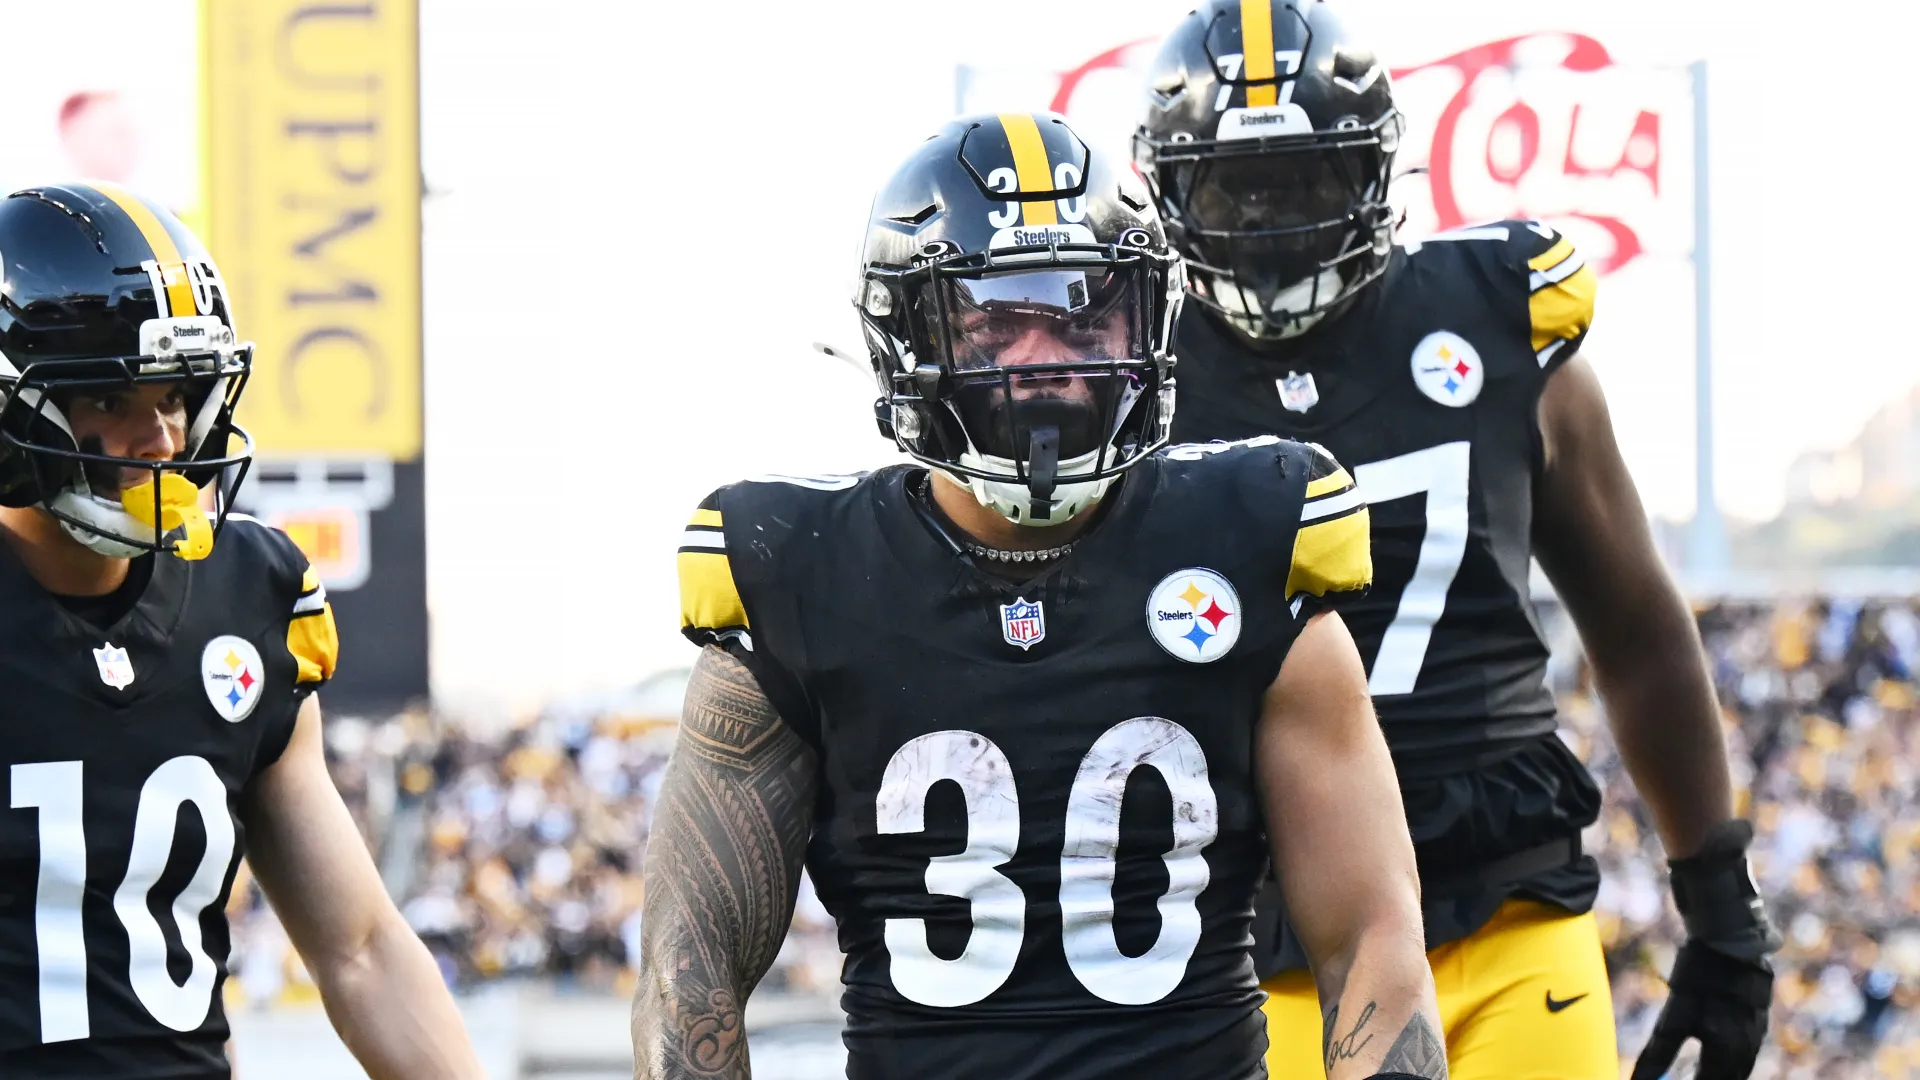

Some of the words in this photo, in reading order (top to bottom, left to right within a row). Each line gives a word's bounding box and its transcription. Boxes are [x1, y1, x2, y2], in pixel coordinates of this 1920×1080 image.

[1214, 50, 1302, 111] 77
[275, 2, 389, 426] UPMC
[988, 163, 1087, 228] 30
[1013, 228, 1071, 245] Steelers
[173, 325, 205, 337] Steelers
[1353, 441, 1470, 696] 7
[1009, 620, 1039, 639] NFL
[1157, 611, 1193, 621] Steelers
[876, 716, 1218, 1008] 30
[11, 755, 235, 1044] 10
